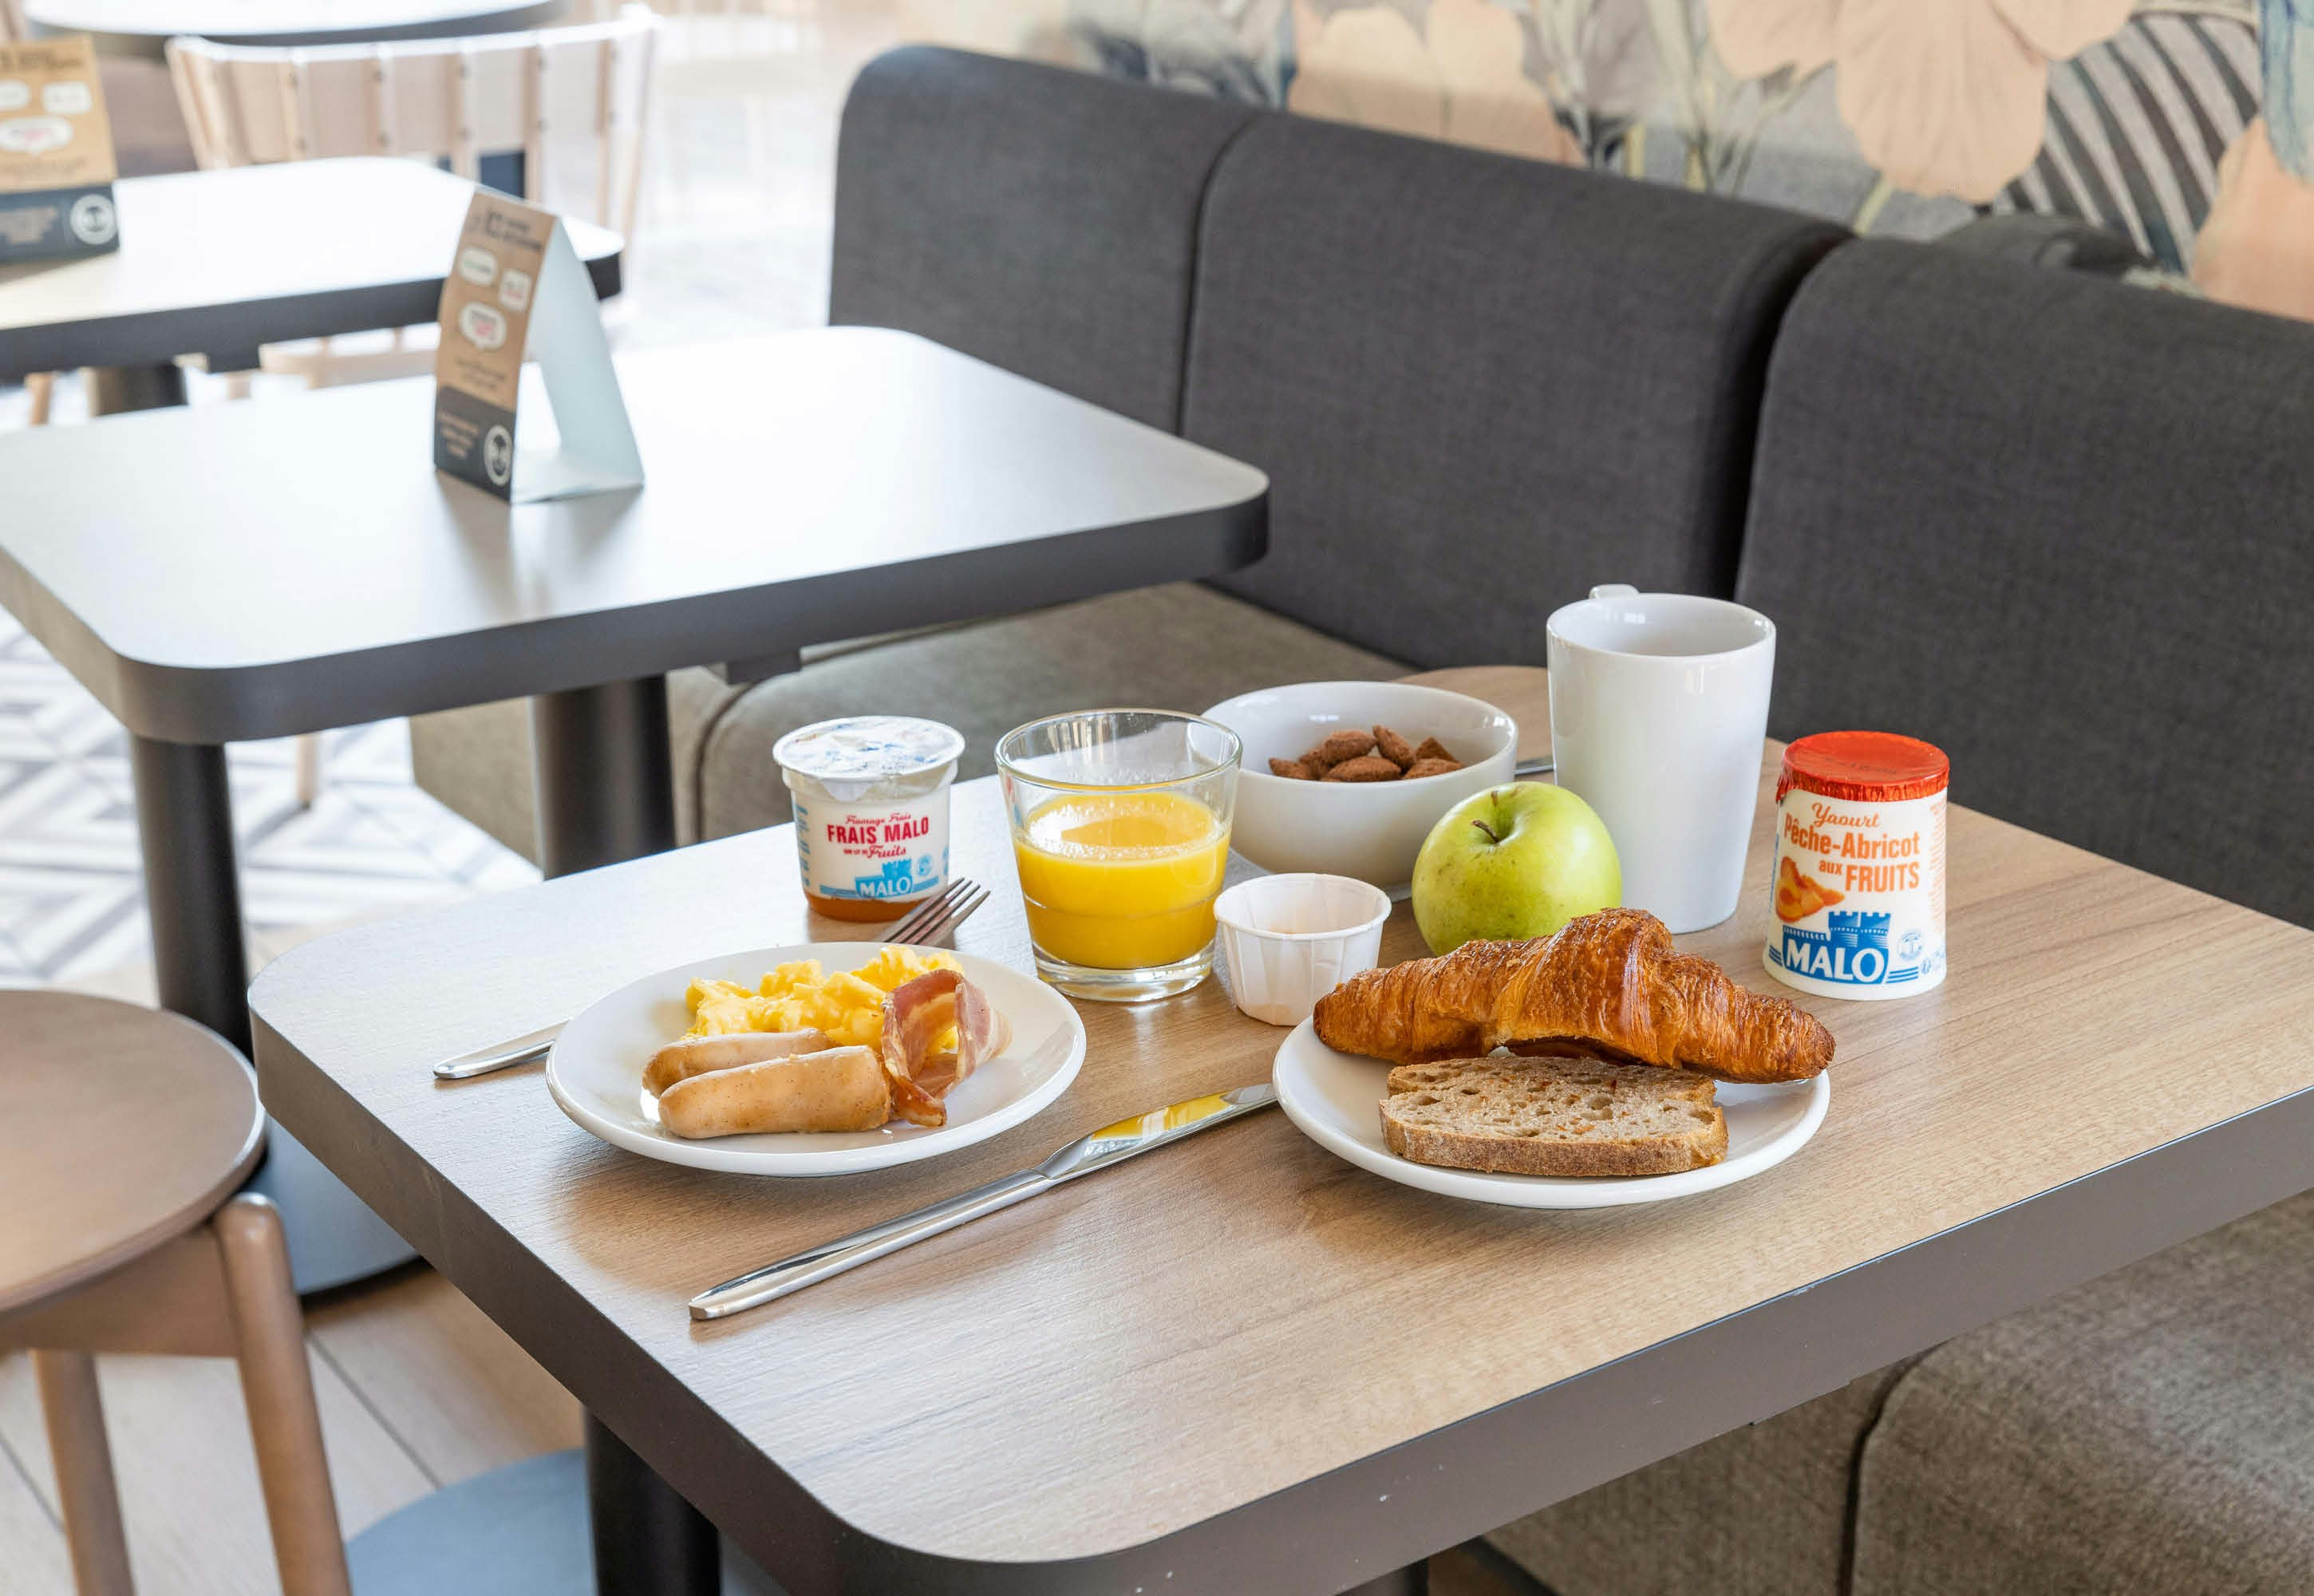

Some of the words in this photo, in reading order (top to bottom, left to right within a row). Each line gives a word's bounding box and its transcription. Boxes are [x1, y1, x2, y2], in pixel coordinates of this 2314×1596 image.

[1812, 802, 1880, 828] Yaourt
[827, 824, 877, 844] FRAIS
[884, 816, 930, 843] MALO
[1783, 811, 1921, 859] Pêche-Abricot
[867, 844, 906, 859] Fruits
[859, 876, 911, 897] MALO
[1818, 859, 1843, 876] aux
[1845, 861, 1920, 893] FRUITS
[1785, 938, 1886, 983] MALO
